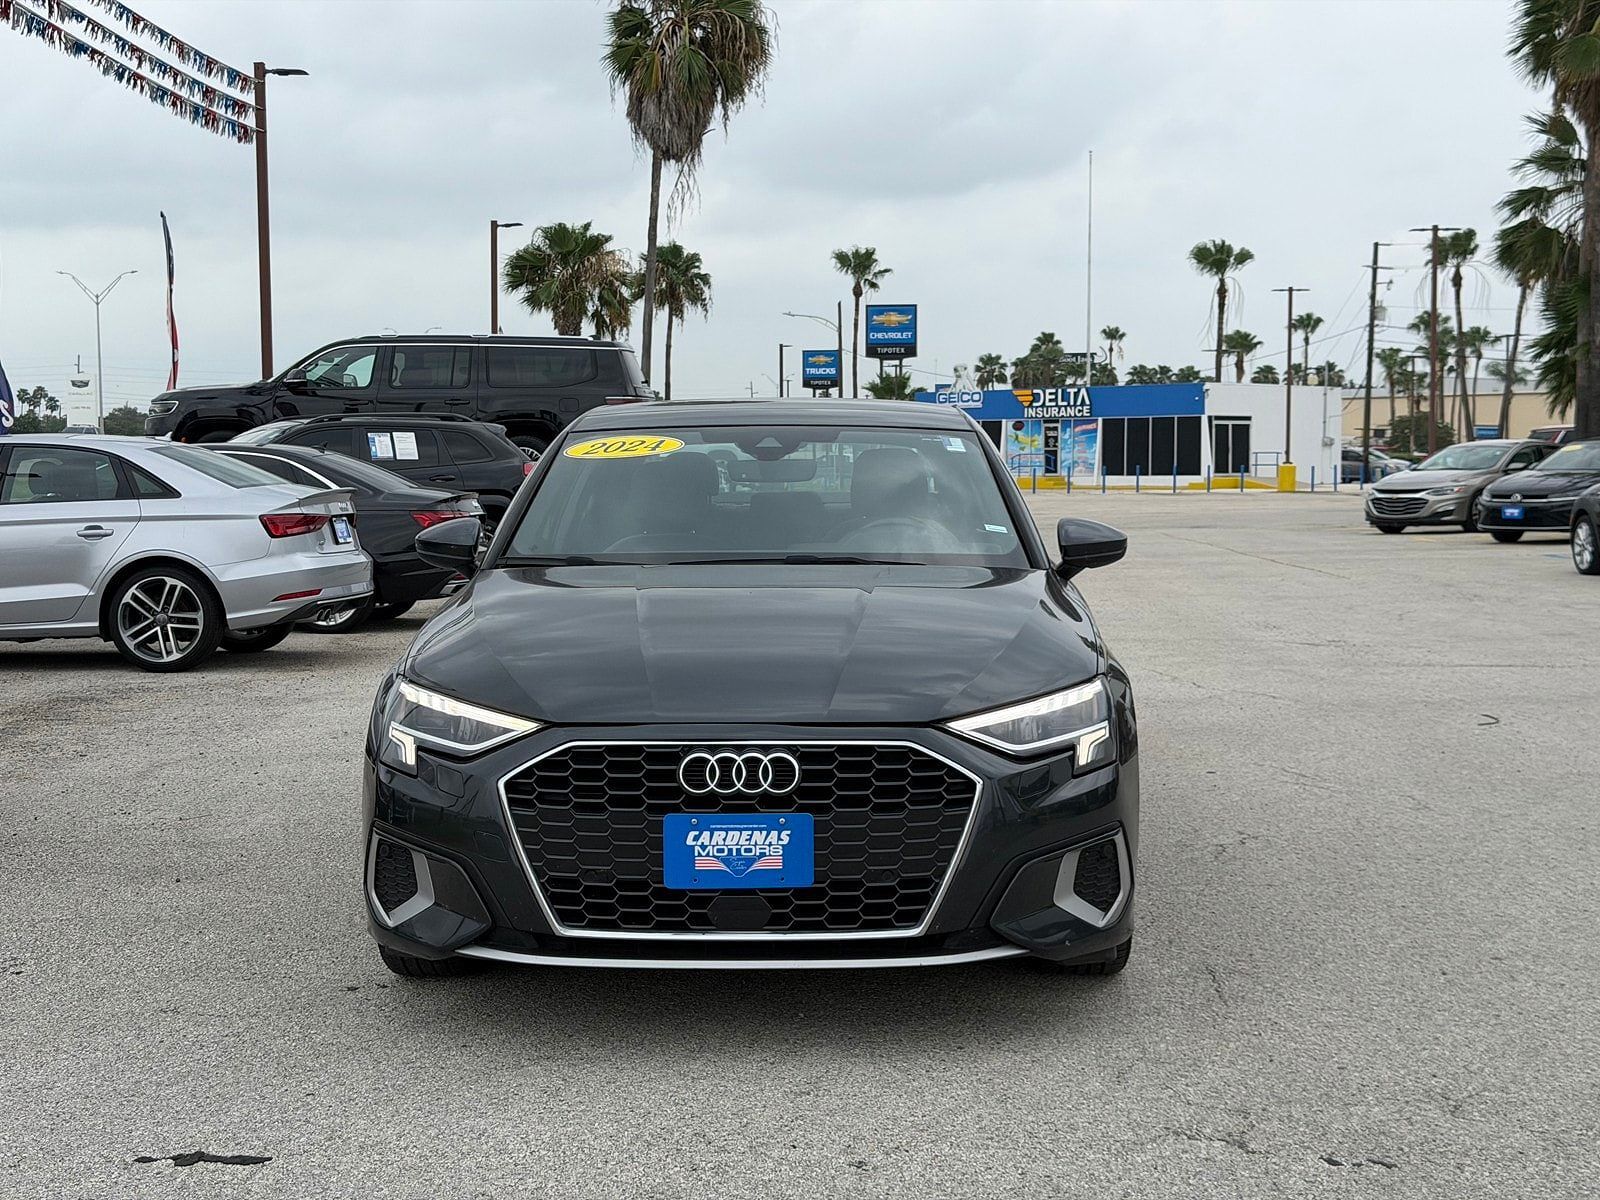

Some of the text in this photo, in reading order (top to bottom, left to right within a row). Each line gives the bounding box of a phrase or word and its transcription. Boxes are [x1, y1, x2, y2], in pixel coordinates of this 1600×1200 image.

[805, 367, 836, 375] TRUCKS
[937, 391, 983, 404] GEICO
[1032, 387, 1091, 407] DELTA
[1024, 405, 1091, 418] INSURANCE
[580, 439, 666, 456] 2024
[686, 830, 791, 845] CARDENAS
[694, 845, 783, 856] MOTORS
